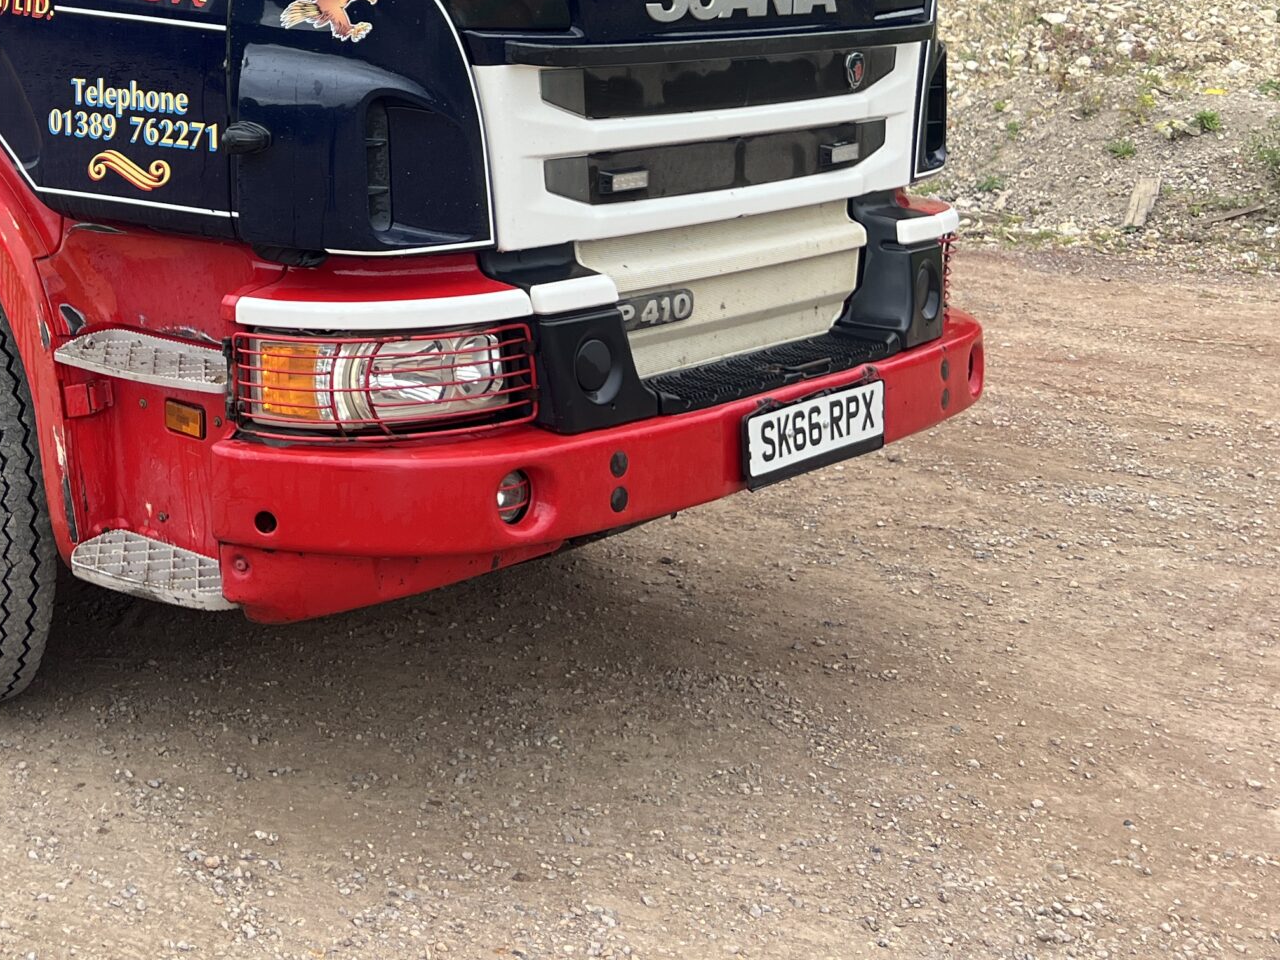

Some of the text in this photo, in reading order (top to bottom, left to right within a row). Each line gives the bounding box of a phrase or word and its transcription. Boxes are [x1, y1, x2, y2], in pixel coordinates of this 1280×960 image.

[71, 78, 189, 117] Telephone
[48, 109, 218, 151] 01389 762271
[641, 293, 691, 324] 410
[761, 390, 874, 462] SK66 RPX
